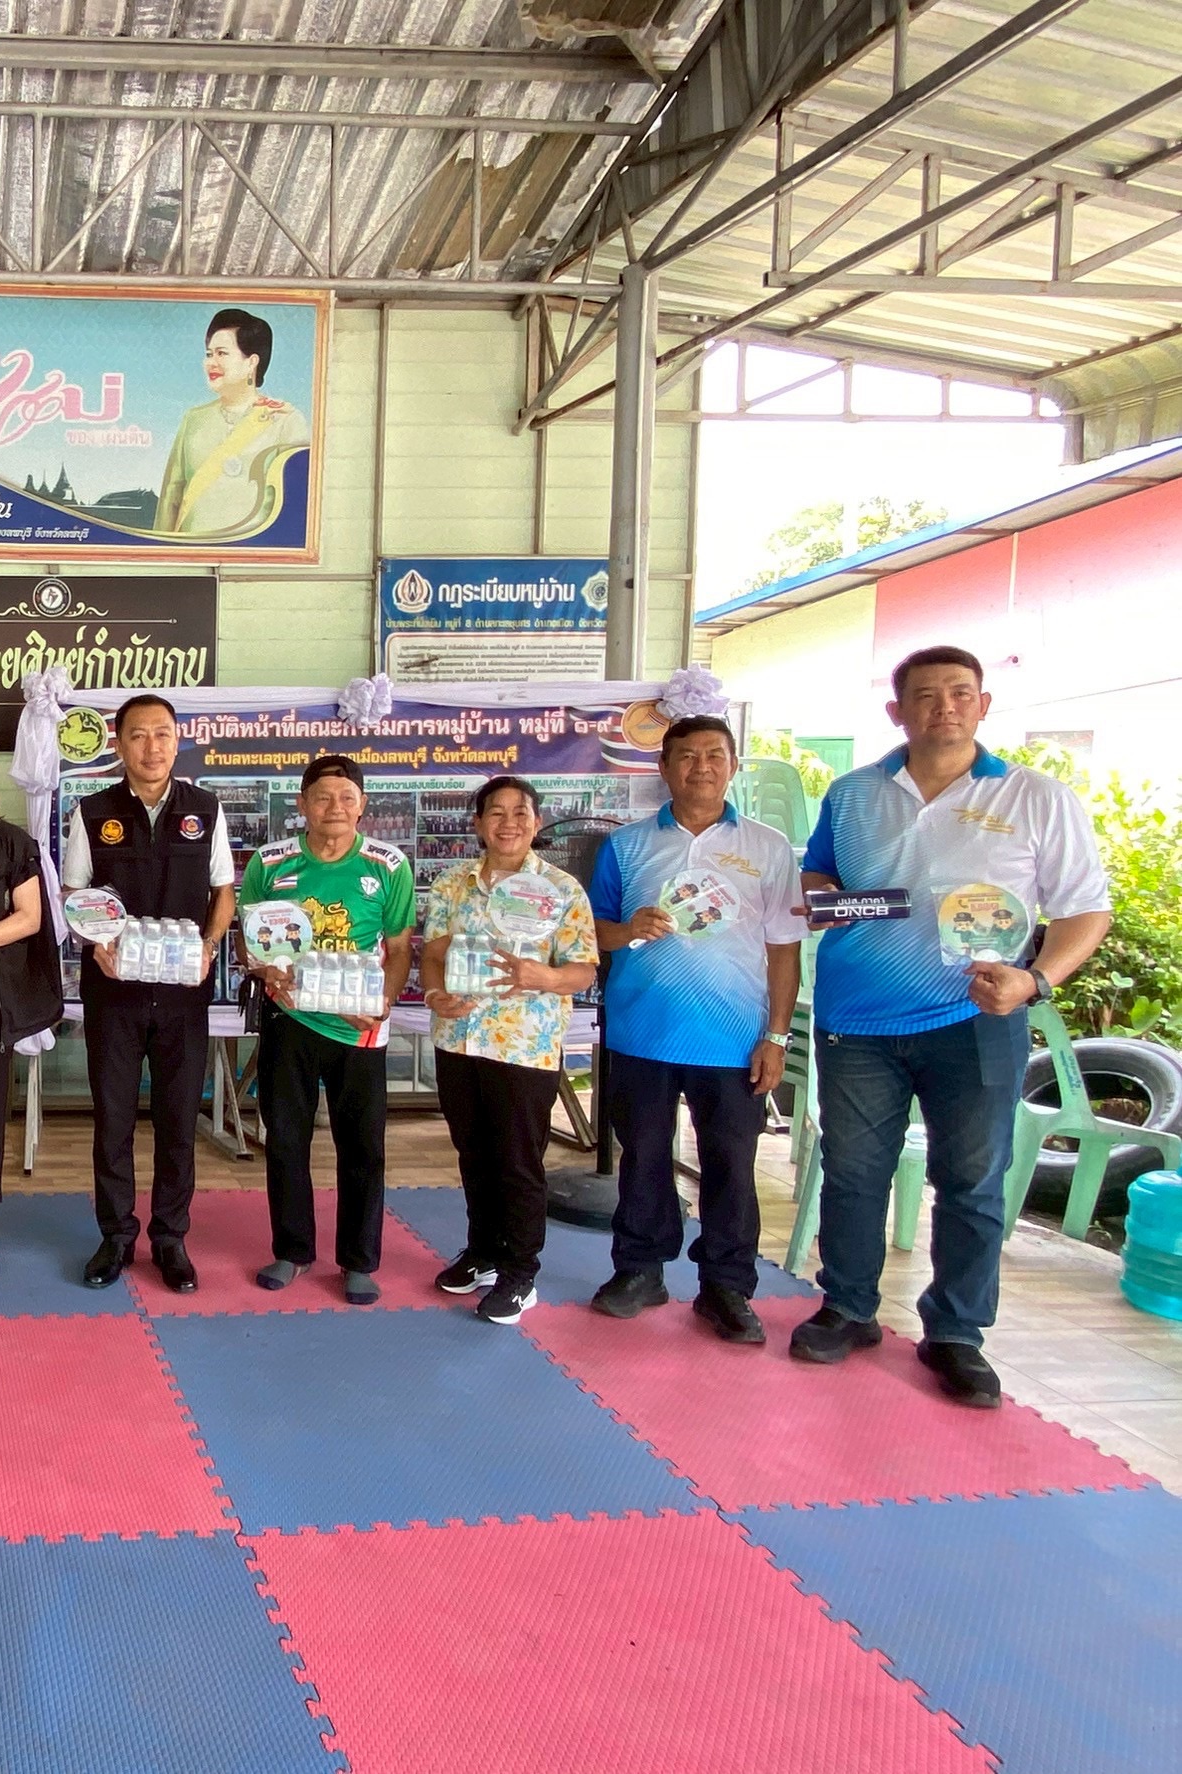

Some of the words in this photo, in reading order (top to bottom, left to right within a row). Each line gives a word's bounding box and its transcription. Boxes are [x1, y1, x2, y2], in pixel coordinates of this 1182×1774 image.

[35, 526, 89, 541] จังหวัดลพบุรี
[438, 577, 575, 608] กฎระเบียบหมู่บ้าน
[445, 618, 461, 631] หมู่ที่
[519, 707, 565, 743] หมู่ที่
[204, 749, 309, 770] ตำบลทะเลชุบศร
[432, 745, 517, 768] จังหวัดลพบุรี
[261, 847, 284, 858] SPORT
[367, 845, 390, 858] SPORT
[834, 906, 889, 917] ONCB
